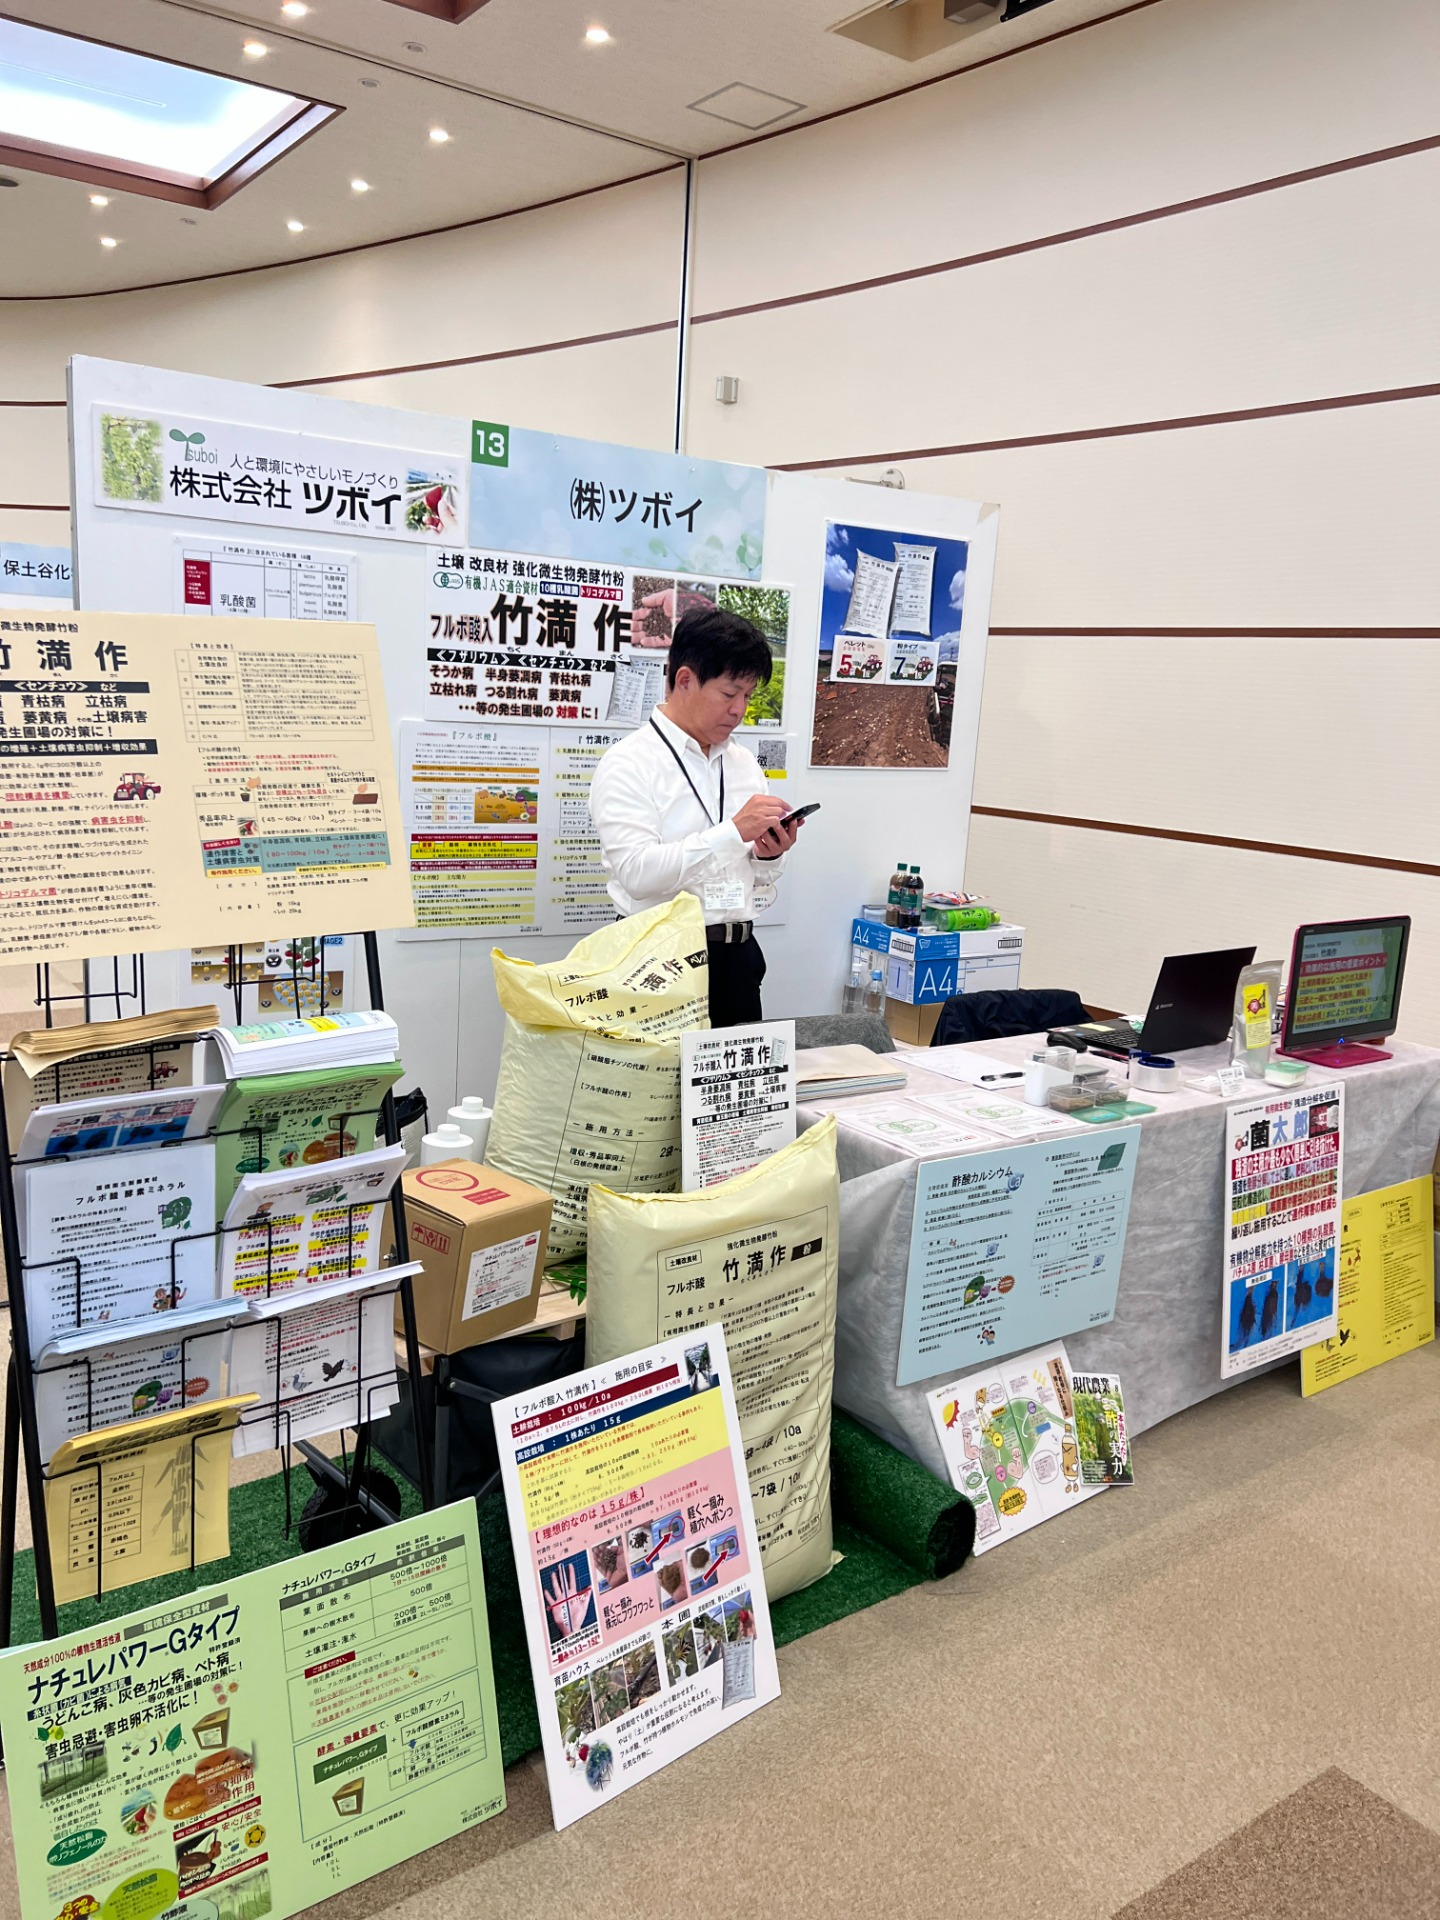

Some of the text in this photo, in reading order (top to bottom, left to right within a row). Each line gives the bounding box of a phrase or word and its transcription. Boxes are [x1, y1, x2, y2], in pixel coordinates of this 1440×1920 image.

[476, 429, 504, 457] 13
[230, 454, 398, 489] 人と環境にやさしいモノづくり
[169, 465, 401, 524] 株式会社 ツボイ
[570, 478, 703, 532] (株)ツボイ
[4, 560, 73, 580] 保土谷化
[437, 553, 624, 587] 土壌 改良材 強化微生物発酵竹粉
[464, 576, 538, 595] 有機JAS適合資材
[220, 594, 256, 608] 乳酸菌
[430, 593, 633, 652] フルボ酸入 竹満作
[590, 660, 607, 672] など
[840, 654, 852, 675] 5
[894, 657, 906, 676] 7
[430, 665, 592, 686] そうか病 半身萎凋病 青枯れ病
[100, 683, 117, 692] など
[430, 683, 581, 702] 立枯れ病 つる割れ病 萎黄病
[21, 695, 127, 708] 青枯病 立枯病
[23, 711, 68, 725] 萎黄病
[556, 707, 578, 718] 対策
[581, 708, 598, 718] に！
[453, 731, 497, 742] 『フルボ酸』
[207, 856, 260, 866] 土壌病害虫対策
[853, 925, 870, 946] A4
[918, 965, 953, 998] A4
[565, 988, 609, 1007] フルボ酸
[724, 1036, 764, 1047] 強化微生物発酵竹粉
[693, 1045, 770, 1072] フルボ酸入 竹満作
[580, 1083, 631, 1099] 【フルボ酸の作用】
[738, 1079, 756, 1089] 青枯病
[762, 1075, 780, 1085] 立枯病
[701, 1093, 732, 1106] つる割れ病
[1250, 1110, 1308, 1151] 菌太郎
[951, 1166, 1013, 1188] 酢酸カルシウム
[1008, 1175, 1020, 1188] Ca
[76, 1181, 185, 1205] フルボ酸 酵素ミネラル
[670, 1230, 778, 1267] 土壌改良材 強化微生物発酵竹粉
[723, 1245, 786, 1283] 竹満作
[667, 1277, 705, 1296] フルボ酸
[615, 1360, 653, 1381] 施用の目安
[1073, 1377, 1110, 1395] 現代農業
[1115, 1384, 1118, 1392] 8
[512, 1418, 541, 1434] 土耕栽培
[784, 1425, 802, 1439] 10a
[516, 1415, 622, 1461] 高設栽培 1株あたり 15g
[1104, 1410, 1122, 1475] 酢の実力
[687, 1495, 725, 1520] 軽く一掴み
[535, 1508, 597, 1544] 【理想的なのは
[390, 1554, 448, 1580] 500倍～1000倍
[302, 1583, 433, 1616] 葉面散布 500倍
[603, 1596, 632, 1617] 軽く一掴み
[143, 1600, 211, 1632] 環境保全型資材
[302, 1593, 452, 1637] 果樹への樹木散布 200倍～ 500倍
[605, 1597, 655, 1629] 株元にフワフワっと
[24, 1633, 121, 1674] 天然成分100％の植物生理活性液
[208, 1637, 241, 1654] 特許登録済
[553, 1661, 591, 1687] 育苗ハウス
[42, 1652, 230, 1730] うどんこ病、灰色カビ病、ベト病
[394, 1690, 456, 1722] 更に効果アップ！
[45, 1690, 199, 1759] 害虫忌避・害虫卵不活化に！
[410, 1751, 431, 1764] ミネラル
[622, 1749, 653, 1770] 元気な作物に。
[221, 1808, 262, 1832] 安心/安全
[462, 1799, 503, 1824] 株式会社 ツボイ
[63, 1898, 88, 1913] 3つの
